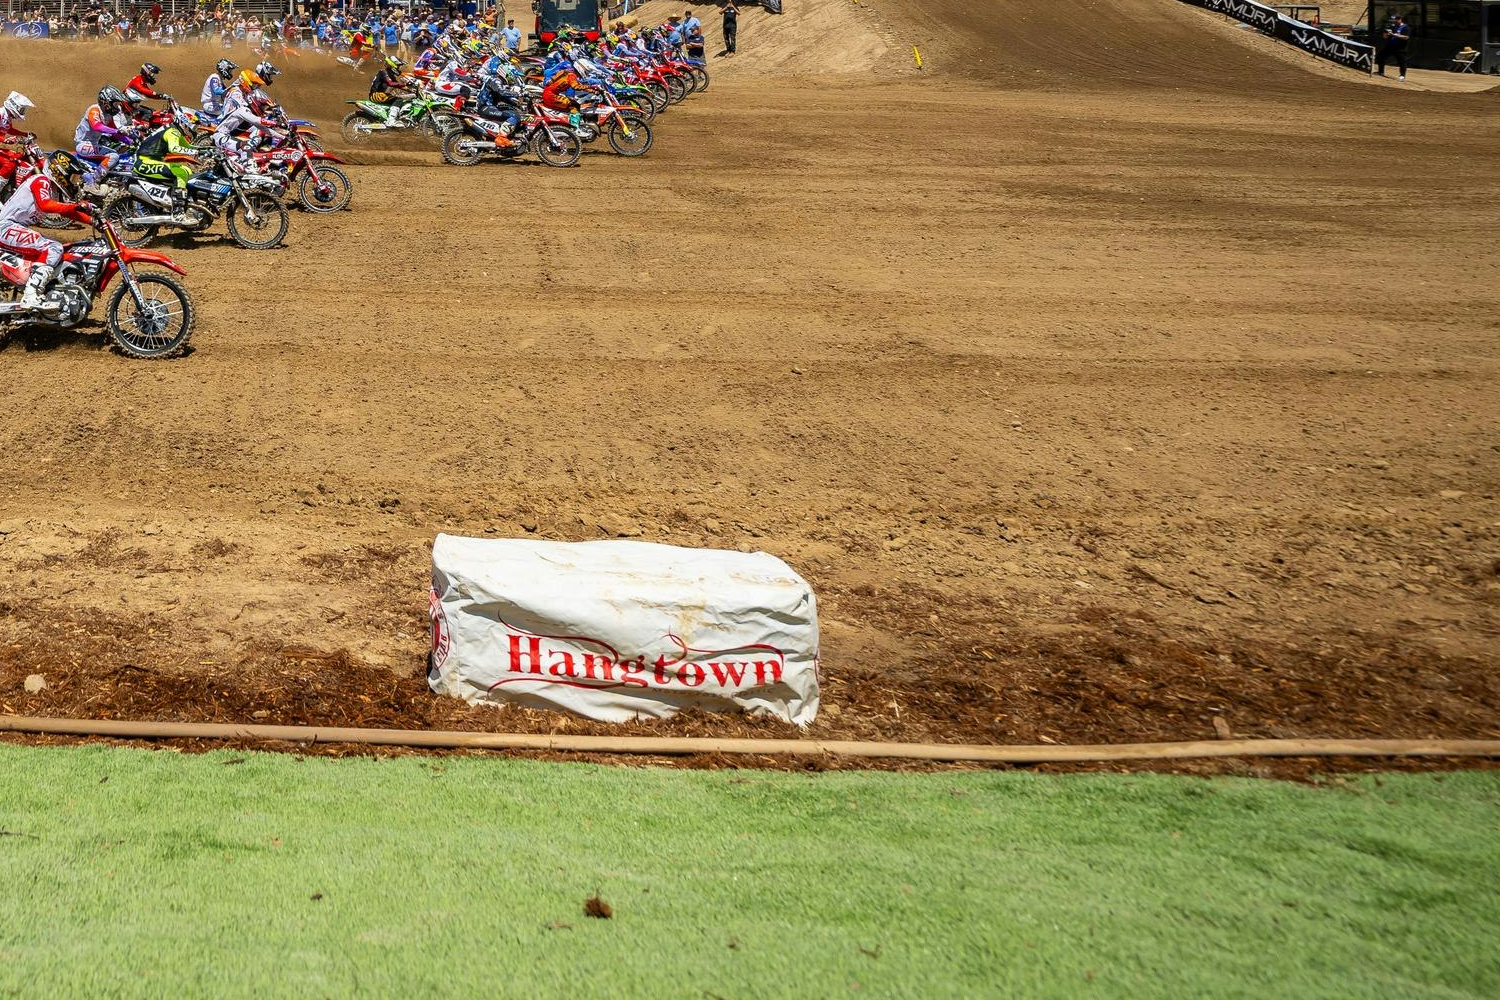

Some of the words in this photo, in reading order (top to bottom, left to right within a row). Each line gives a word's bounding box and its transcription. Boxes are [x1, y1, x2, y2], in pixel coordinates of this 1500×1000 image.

[1291, 29, 1372, 66] NAMURA
[138, 164, 165, 175] FXR
[149, 186, 167, 199] 421
[500, 630, 784, 689] Hangtown
